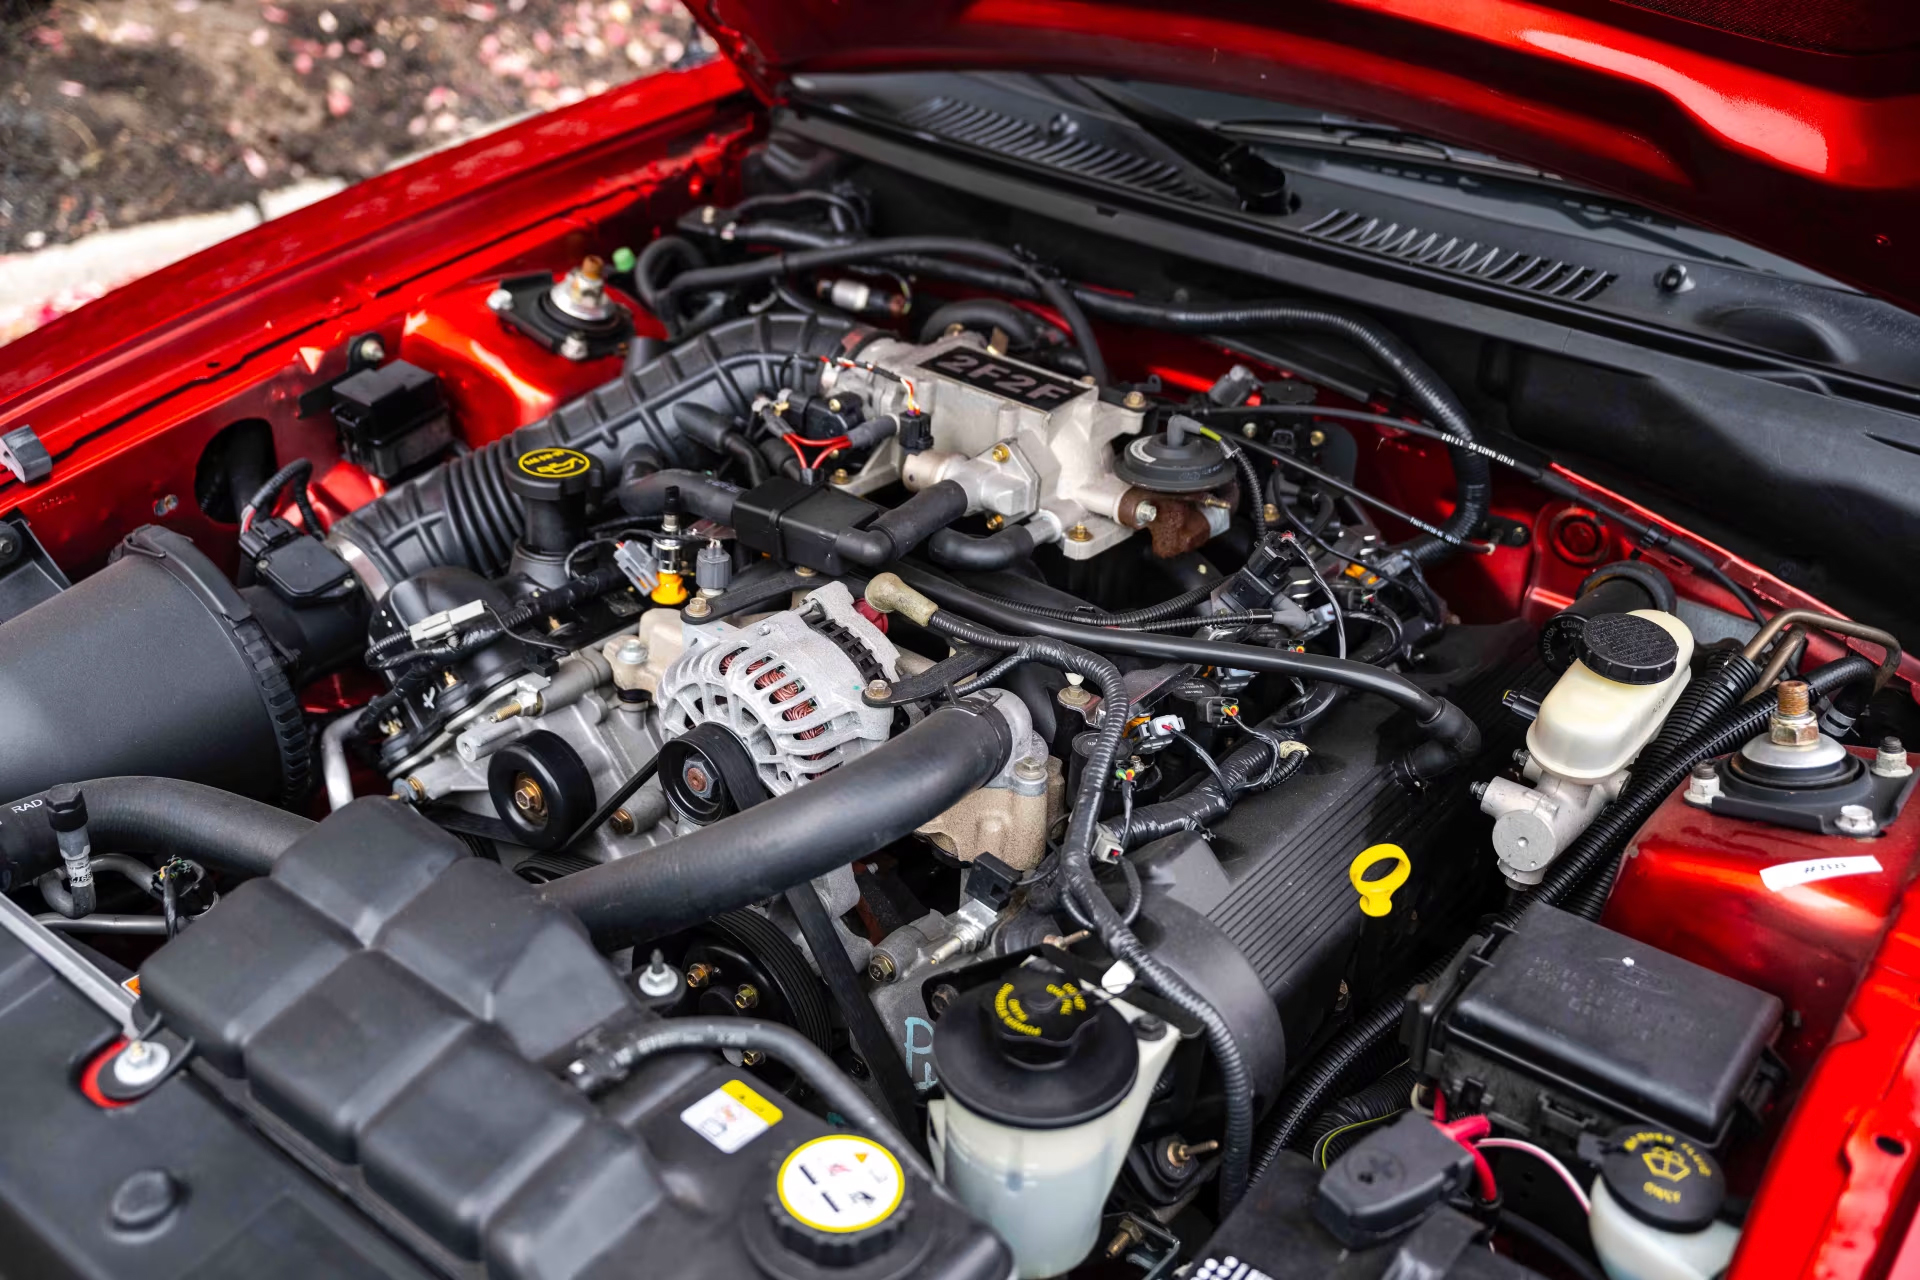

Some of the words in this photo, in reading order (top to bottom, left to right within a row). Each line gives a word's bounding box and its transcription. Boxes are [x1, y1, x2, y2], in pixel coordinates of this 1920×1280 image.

[936, 354, 1071, 400] 2F2F
[1543, 625, 1558, 662] CAUTION
[11, 799, 43, 814] RAD
